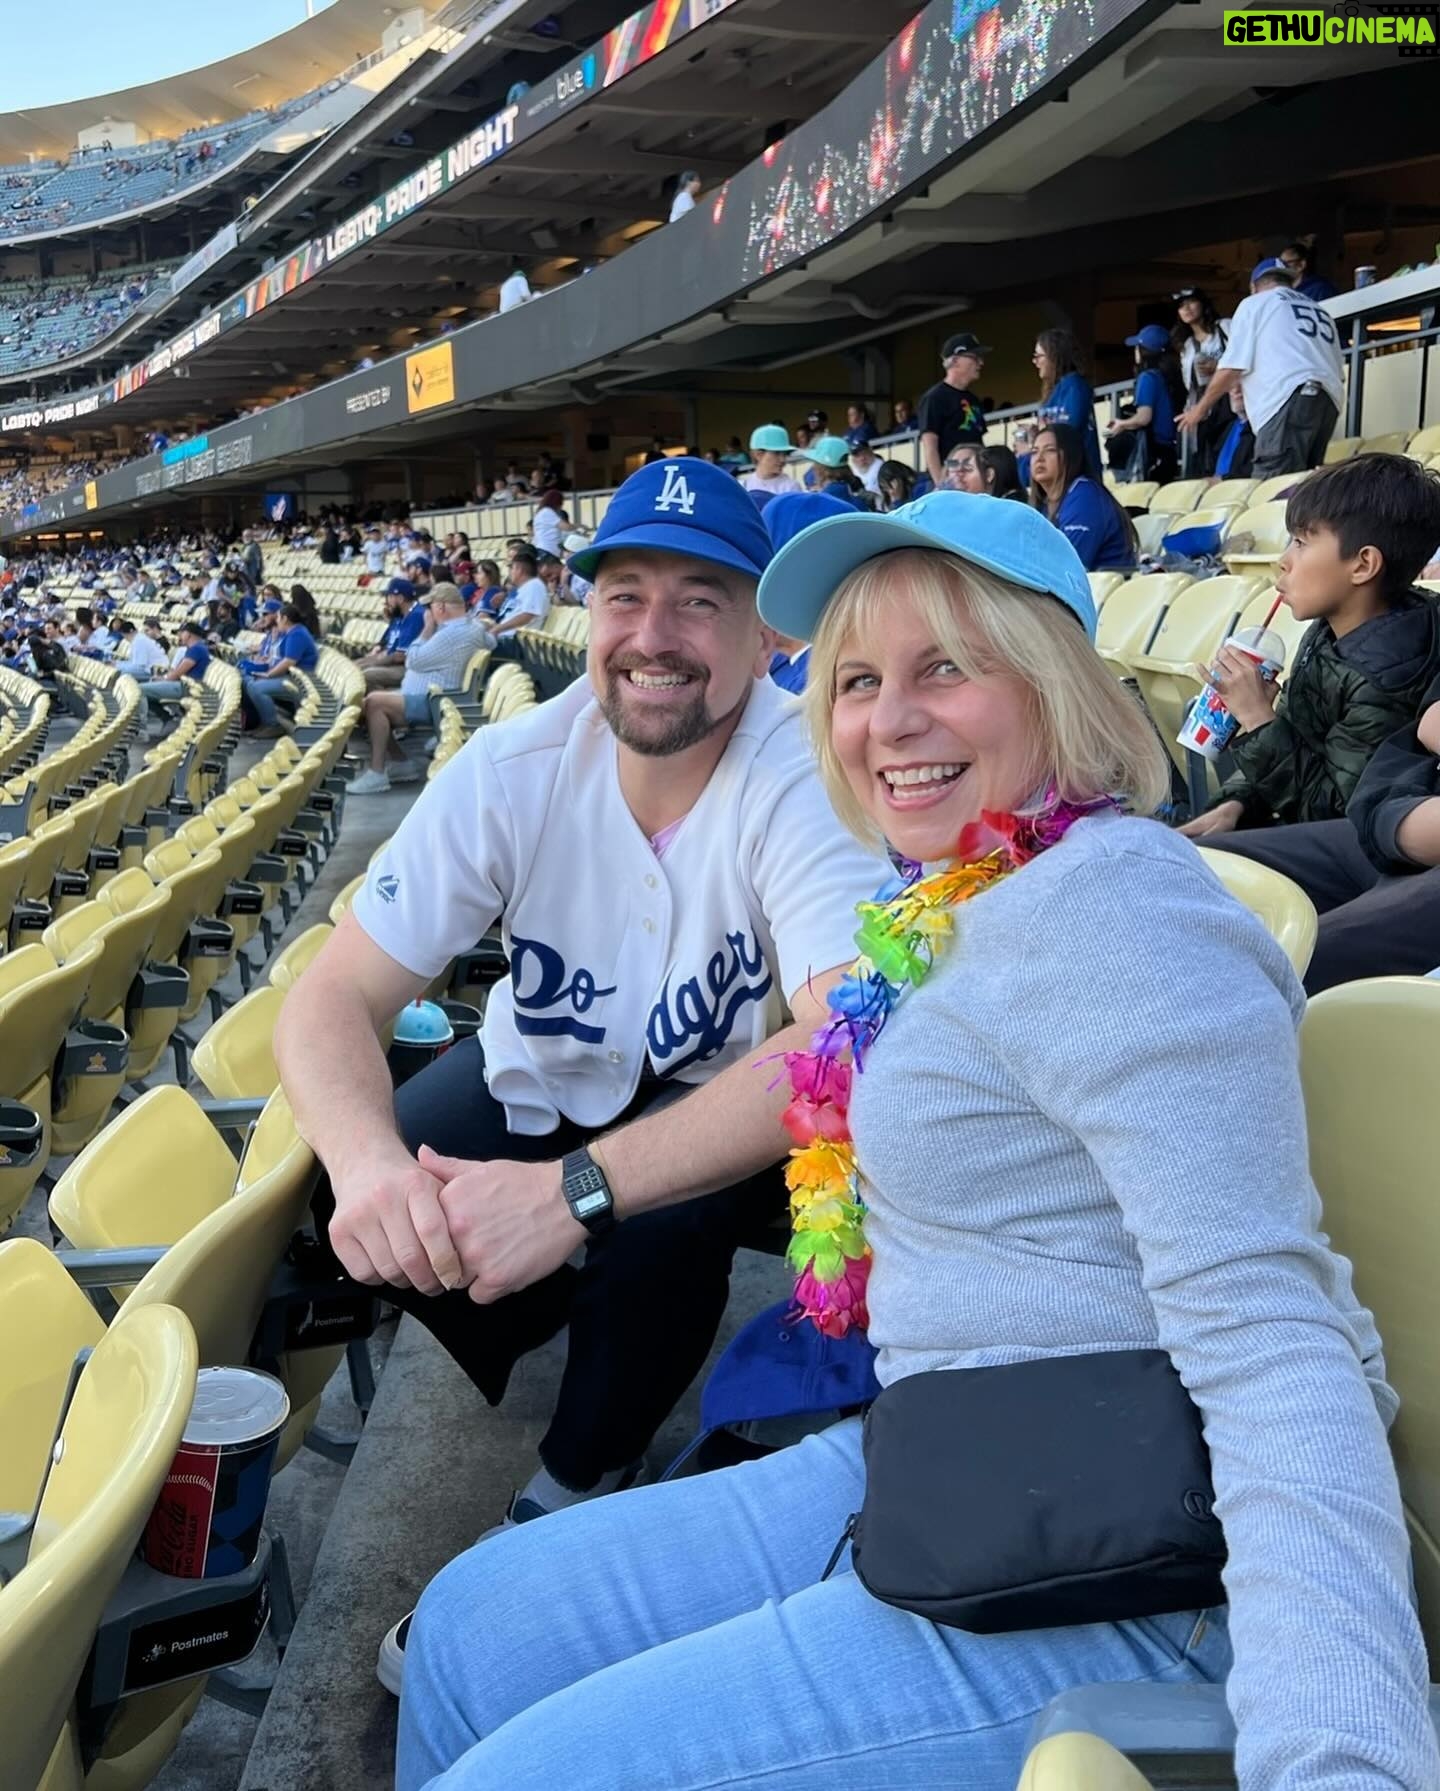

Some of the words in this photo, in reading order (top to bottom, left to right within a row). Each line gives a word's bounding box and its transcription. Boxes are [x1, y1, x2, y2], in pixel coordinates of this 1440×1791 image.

[557, 68, 584, 100] blue
[326, 204, 383, 262] LGBTQ+
[385, 159, 442, 222] PRIDE
[447, 105, 519, 182] NIGHT
[1290, 303, 1336, 344] 55
[654, 465, 696, 515] LA
[511, 920, 769, 1062] Dodger
[170, 1630, 229, 1654] Postmates
